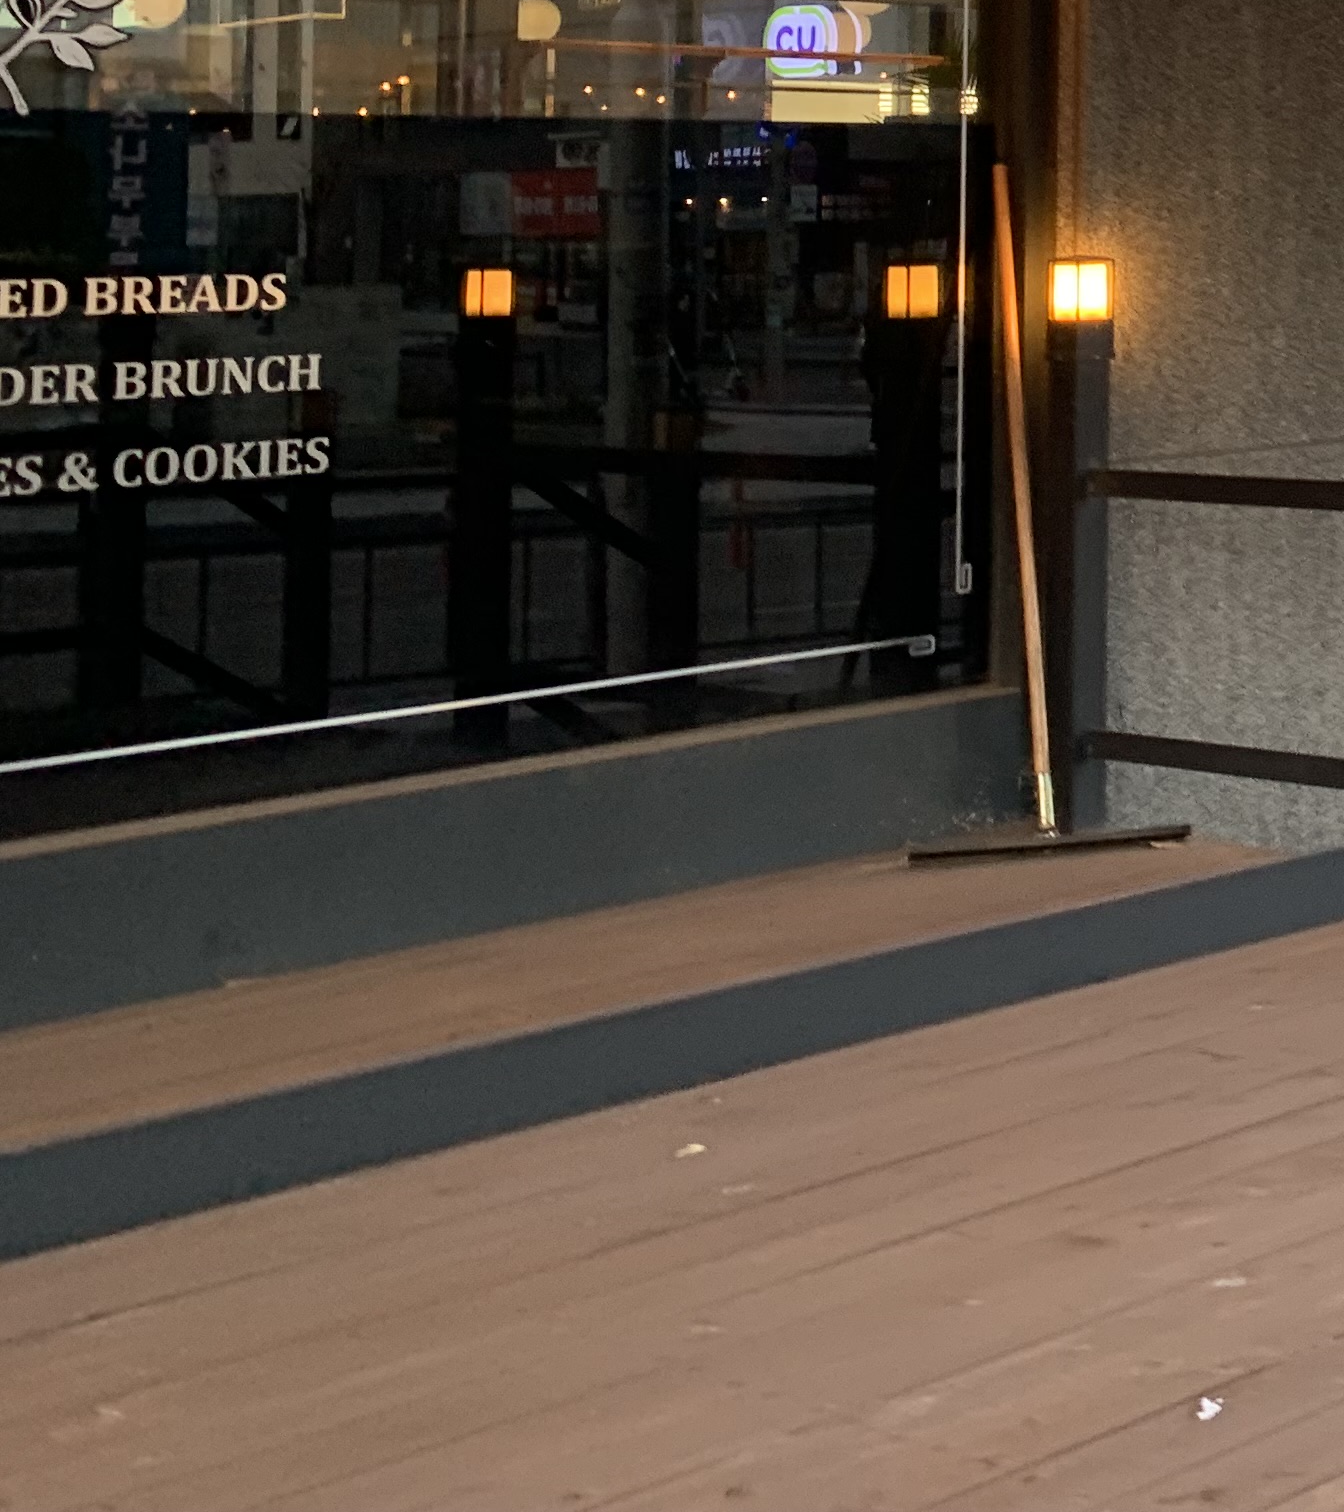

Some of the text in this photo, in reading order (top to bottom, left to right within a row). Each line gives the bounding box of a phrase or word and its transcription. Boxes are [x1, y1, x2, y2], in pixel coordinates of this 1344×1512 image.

[776, 25, 817, 50] CU
[84, 273, 287, 316] BREADS
[113, 353, 323, 402] BRUNCH
[58, 451, 100, 493] &
[113, 437, 330, 488] COOKIES
